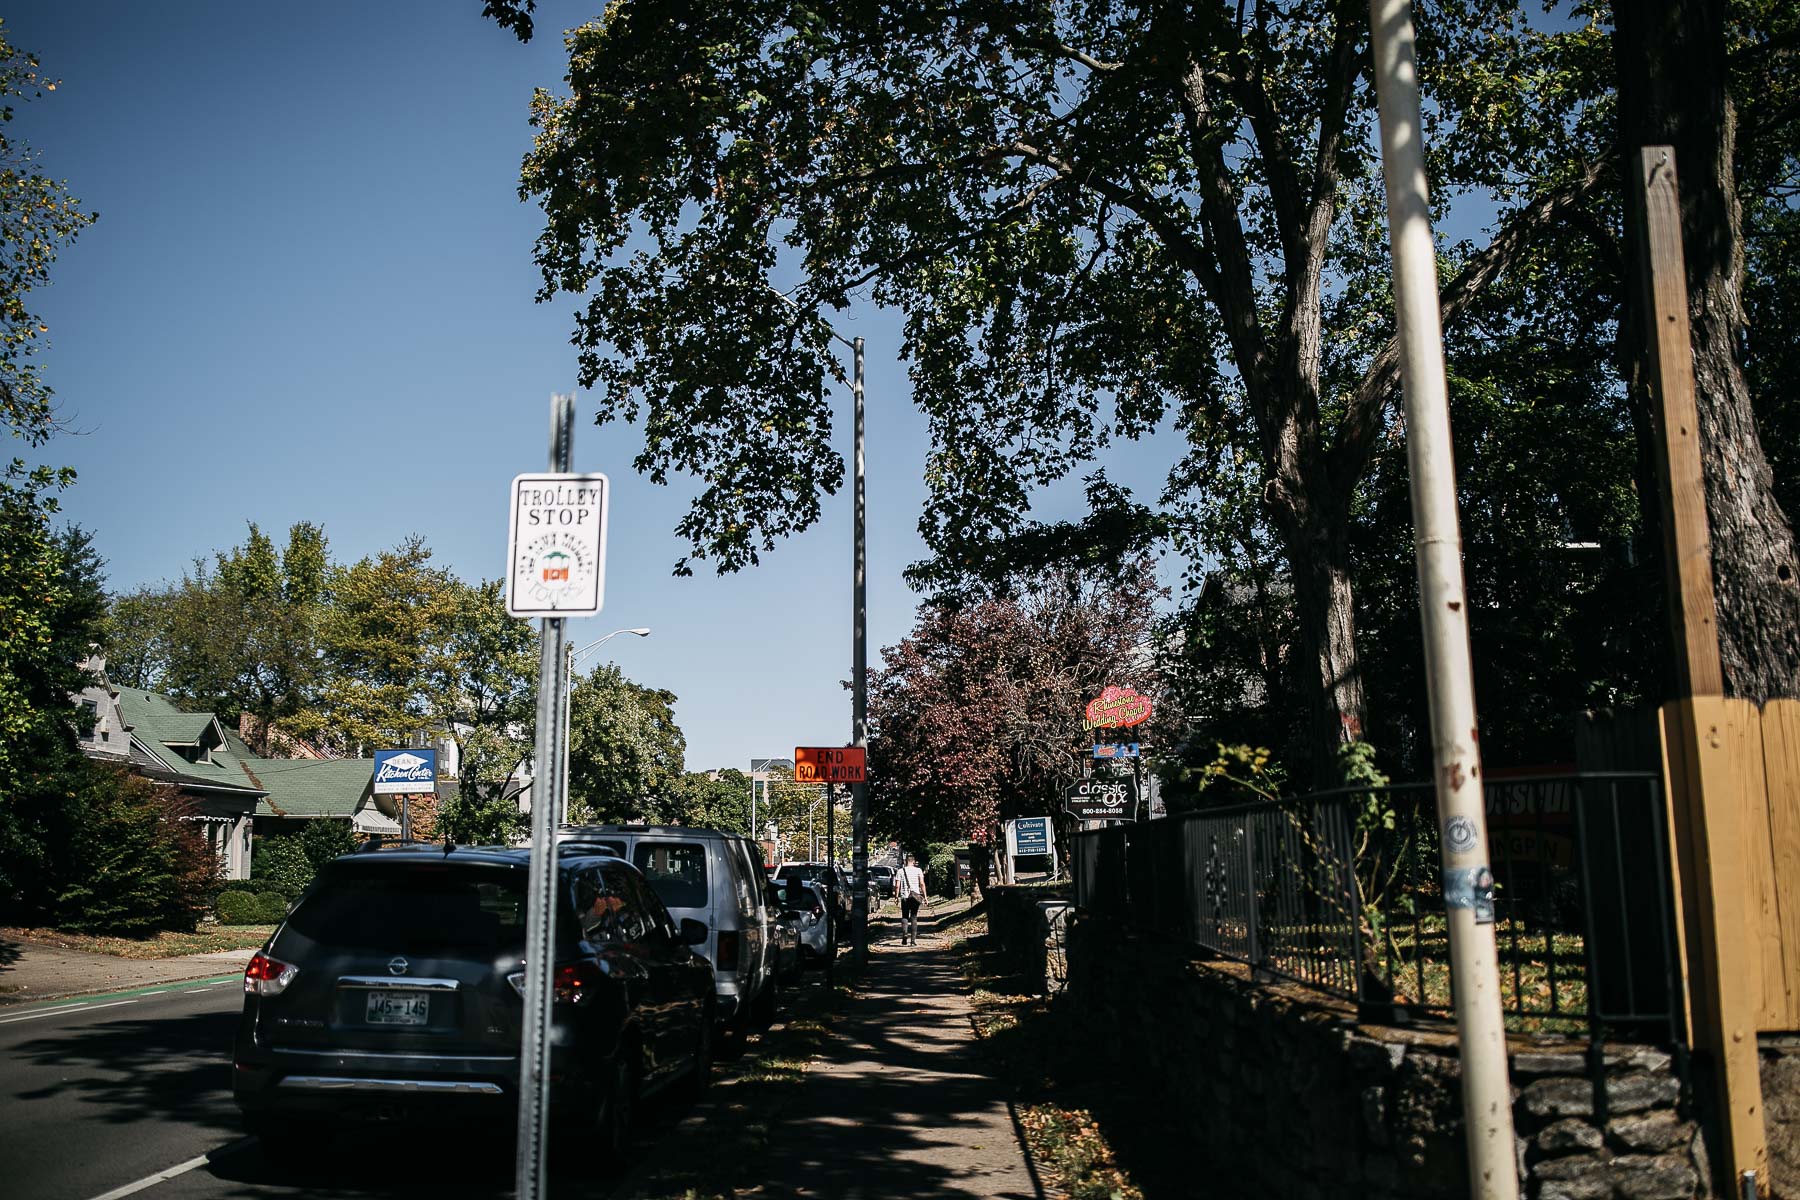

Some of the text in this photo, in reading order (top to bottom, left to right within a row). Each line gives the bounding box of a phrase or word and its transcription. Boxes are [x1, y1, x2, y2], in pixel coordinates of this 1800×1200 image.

[520, 488, 598, 506] TROLLEY
[528, 508, 589, 526] STOP
[1093, 695, 1135, 715] Rhinestone
[1082, 701, 1145, 731] Wedding Chapel
[817, 751, 844, 764] END
[376, 763, 433, 783] Kitchen Center
[799, 766, 862, 779] ROAD WORK
[1079, 780, 1127, 795] classic
[1017, 821, 1044, 830] Cultivate
